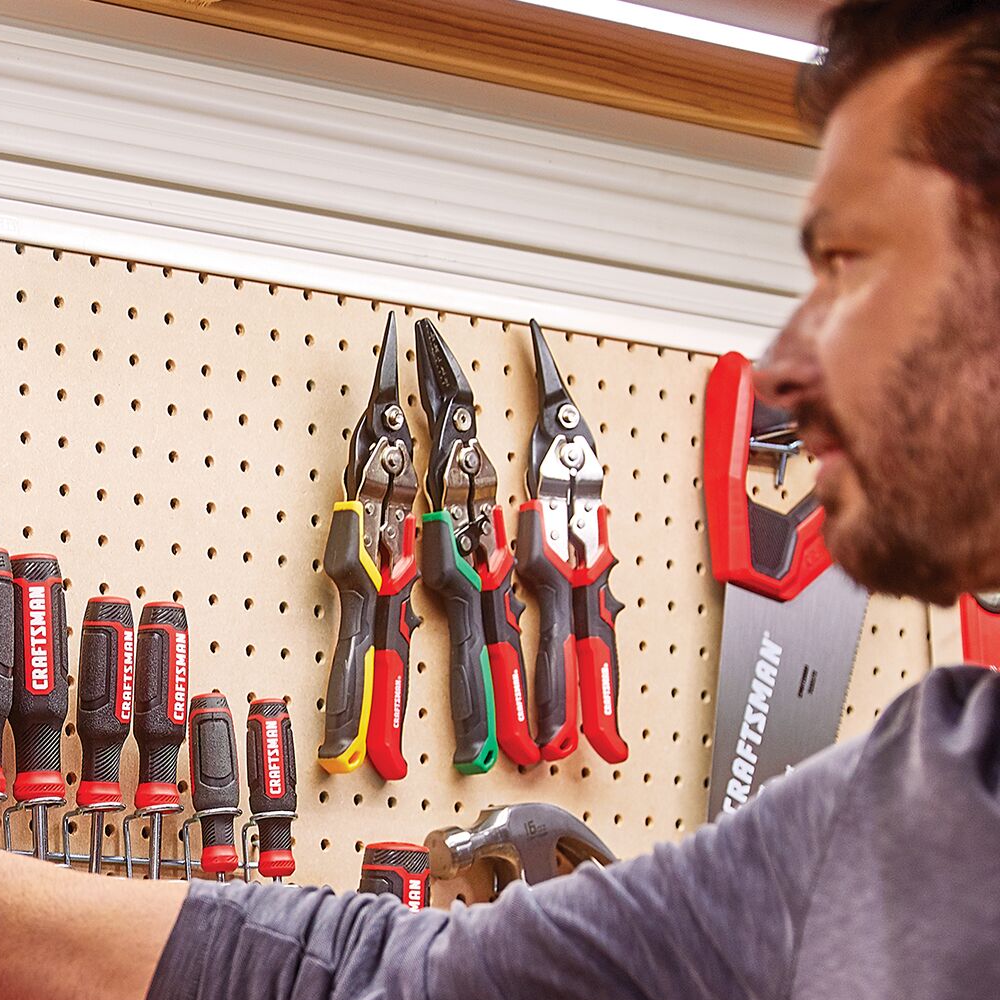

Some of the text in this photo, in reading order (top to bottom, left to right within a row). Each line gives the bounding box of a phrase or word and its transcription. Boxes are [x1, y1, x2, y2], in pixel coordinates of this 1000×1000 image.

[31, 586, 49, 691] CRAFTSMAN
[120, 630, 134, 721] CRAFTSMAN
[173, 632, 189, 722] CRAFTSMAN
[267, 720, 281, 796] CRAFTSMAN
